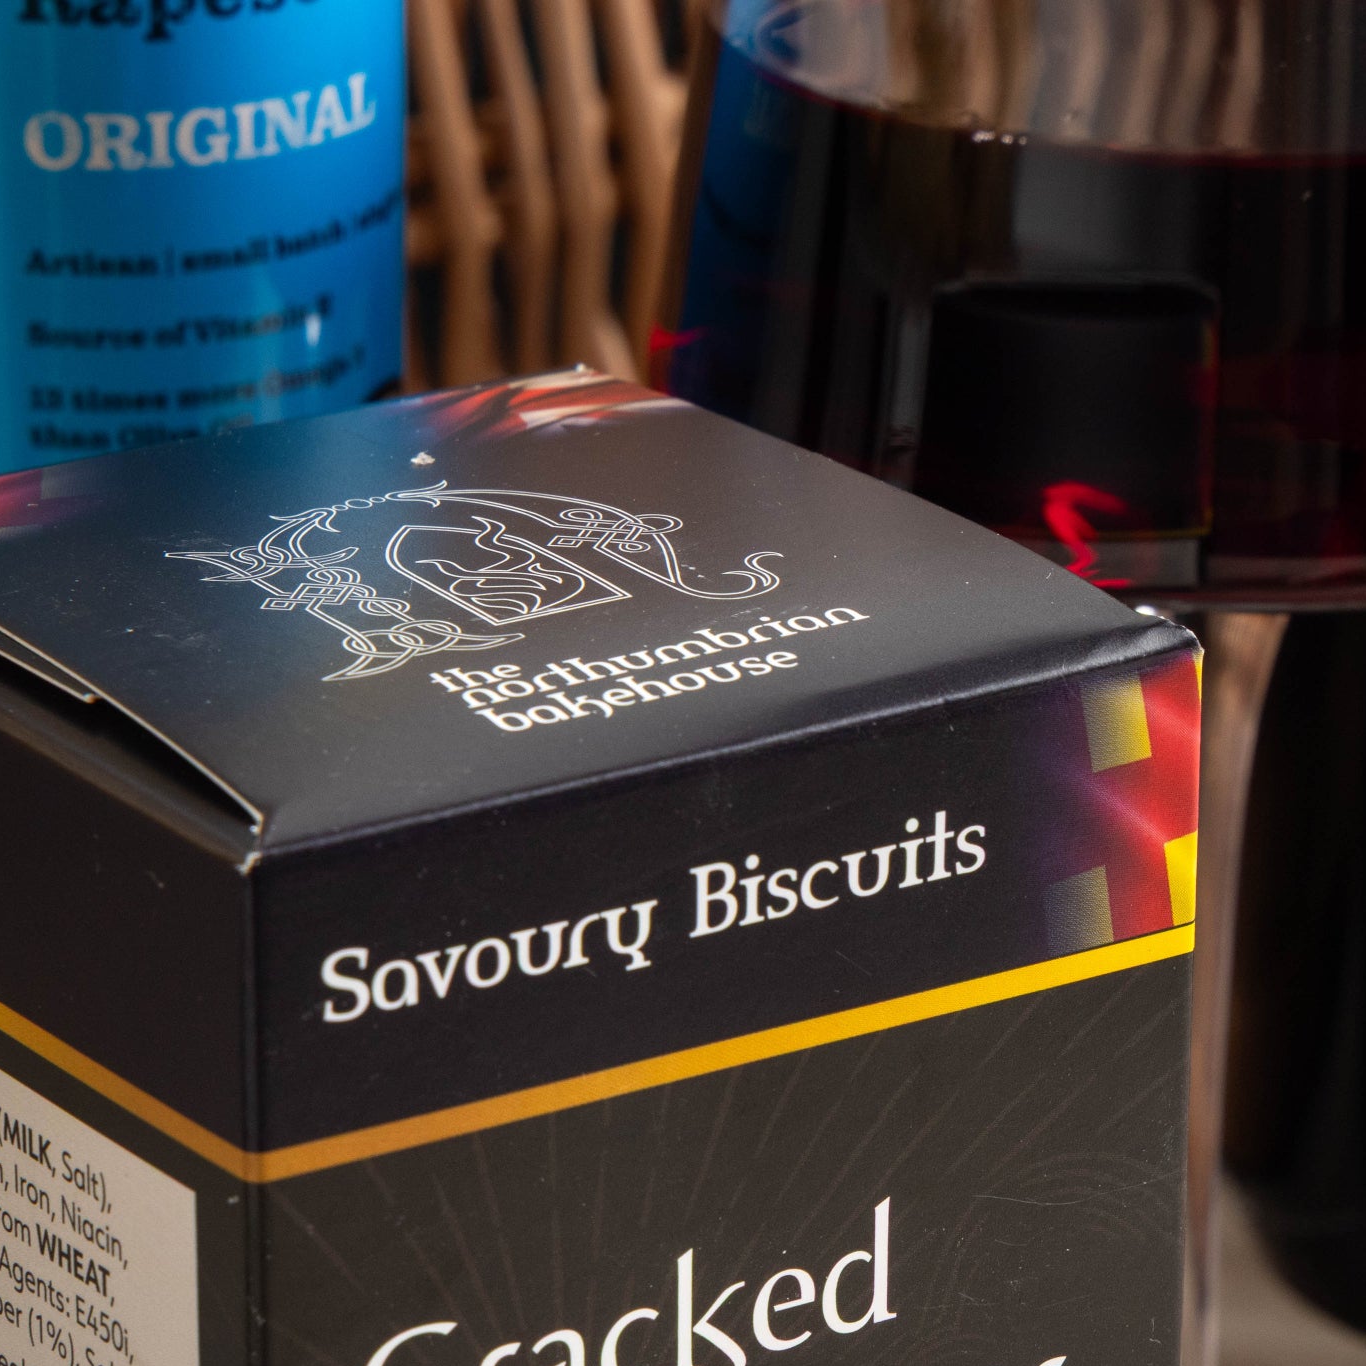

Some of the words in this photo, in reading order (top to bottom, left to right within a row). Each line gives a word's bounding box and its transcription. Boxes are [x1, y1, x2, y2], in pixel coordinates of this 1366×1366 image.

[23, 72, 376, 171] ORIGINAL
[431, 661, 524, 694] the
[459, 606, 871, 710] northumbrian
[474, 650, 799, 733] bakehouse
[320, 898, 659, 1023] Savoury
[688, 809, 987, 938] Biscuits
[13, 1163, 56, 1223] Iron,
[60, 1194, 129, 1271] Niacin,
[61, 1150, 112, 1214] Salt),
[35, 1222, 115, 1308] WHEAT,
[75, 1294, 134, 1366] E450i,
